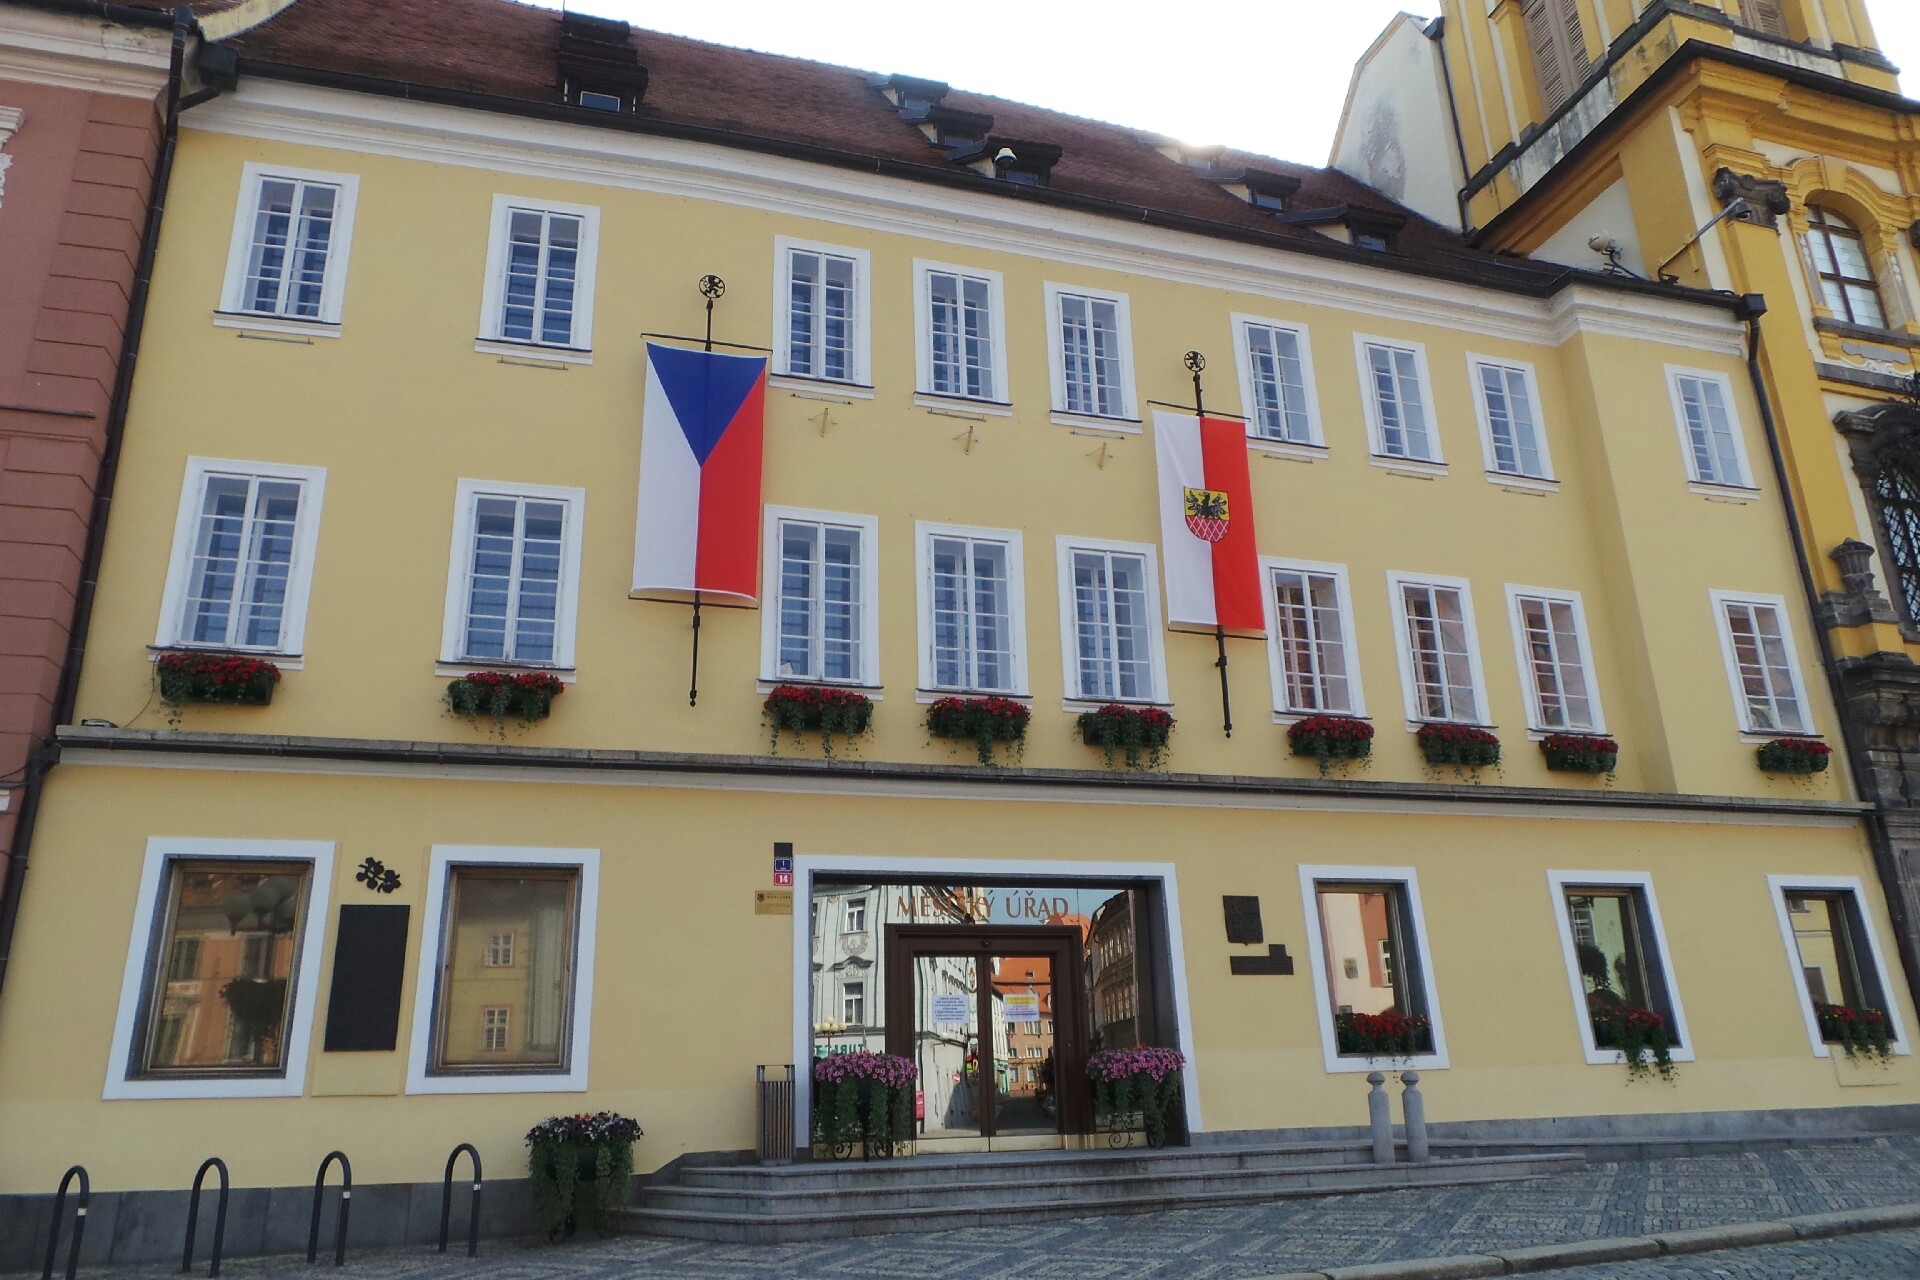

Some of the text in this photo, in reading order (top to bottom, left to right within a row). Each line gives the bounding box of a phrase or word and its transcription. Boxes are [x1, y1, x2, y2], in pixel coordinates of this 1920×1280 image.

[779, 874, 788, 884] 14
[897, 889, 1069, 919] MĚSTSKÝ ÚŘAD
